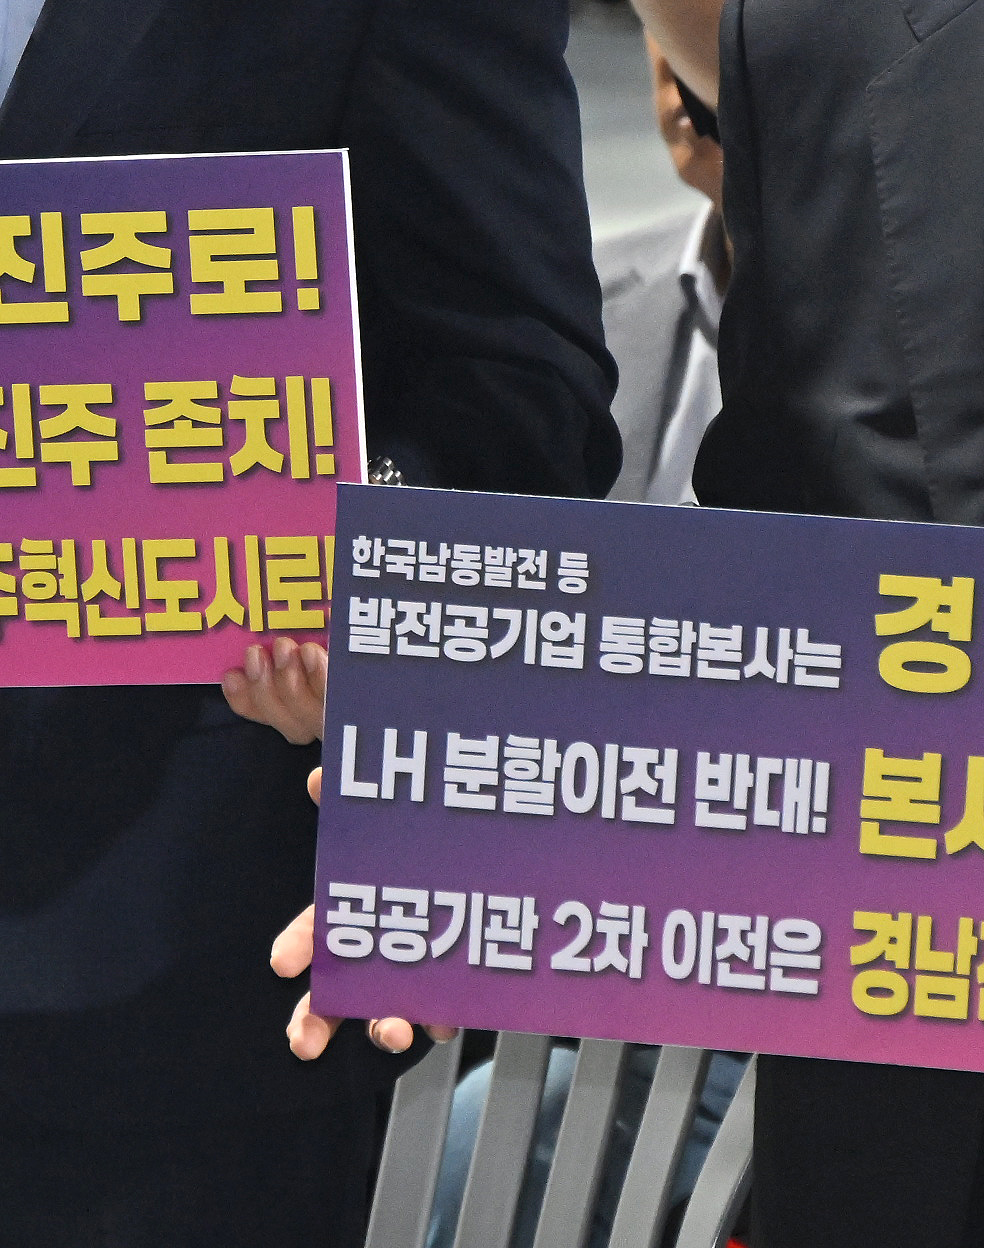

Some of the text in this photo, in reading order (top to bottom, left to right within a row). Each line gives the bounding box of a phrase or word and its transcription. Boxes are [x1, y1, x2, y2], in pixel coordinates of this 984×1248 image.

[144, 375, 335, 483] 존치!
[352, 536, 589, 593] 한국남동발전 등
[349, 596, 586, 669] 발전공기업
[599, 616, 841, 688] 통합본사는
[340, 725, 427, 802] LH
[444, 732, 678, 824] 분할이전
[695, 752, 830, 834] 반대!
[327, 881, 984, 1020] 공공기관 2차 이전은 경남
